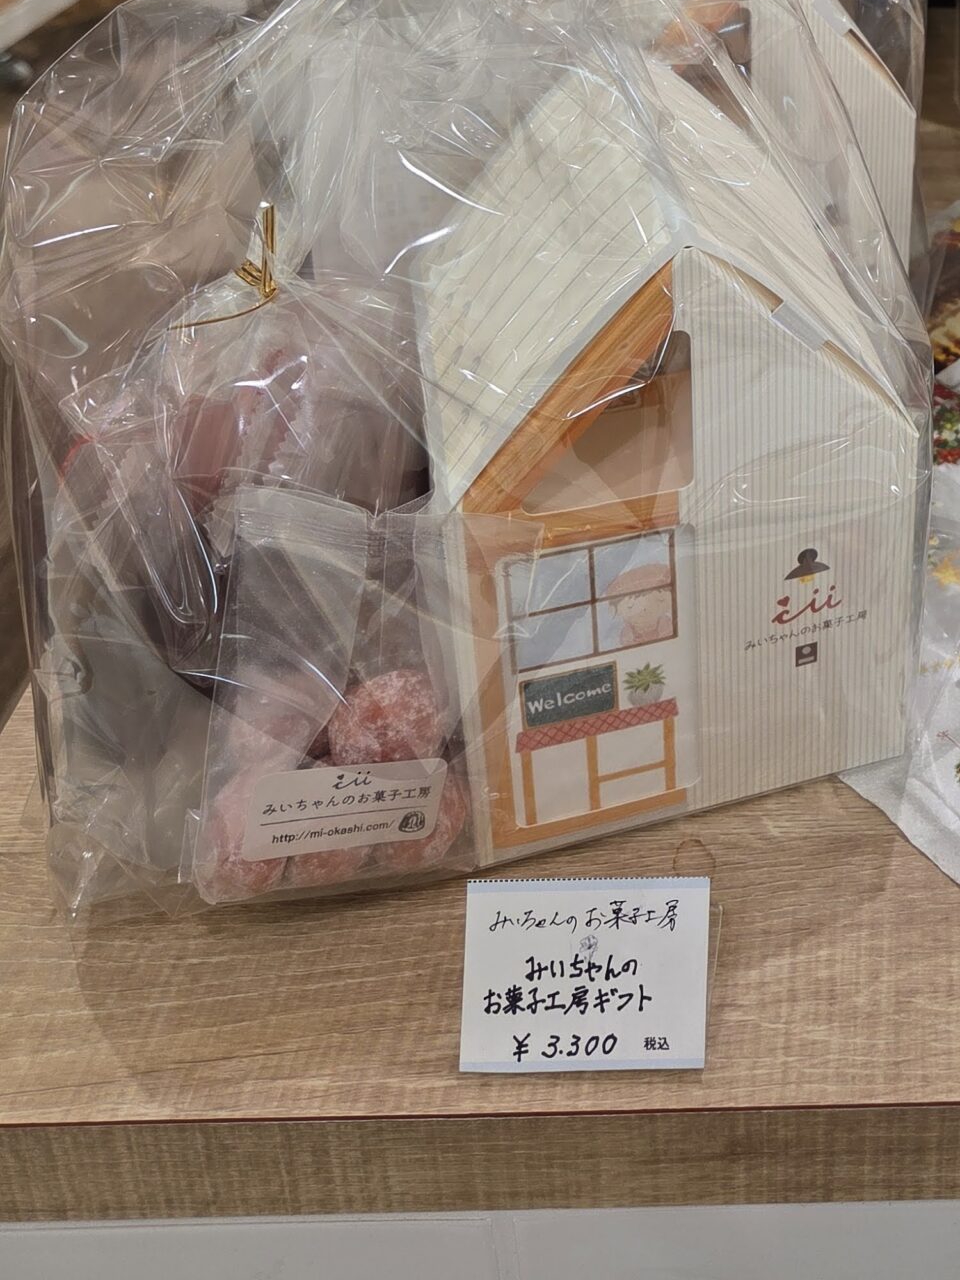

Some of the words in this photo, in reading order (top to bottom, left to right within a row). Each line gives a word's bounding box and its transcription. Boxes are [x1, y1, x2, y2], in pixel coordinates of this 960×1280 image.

[744, 610, 868, 651] みいちゃんのお菓子工房
[527, 681, 612, 715] Welcome
[262, 786, 432, 816] みいちゃんのお菓子工房
[272, 820, 395, 844] http://mi-okashi.com/
[525, 954, 639, 982] みいちゃんの
[483, 984, 652, 1015] お菓子工房ギフト
[643, 1036, 670, 1051] 税込
